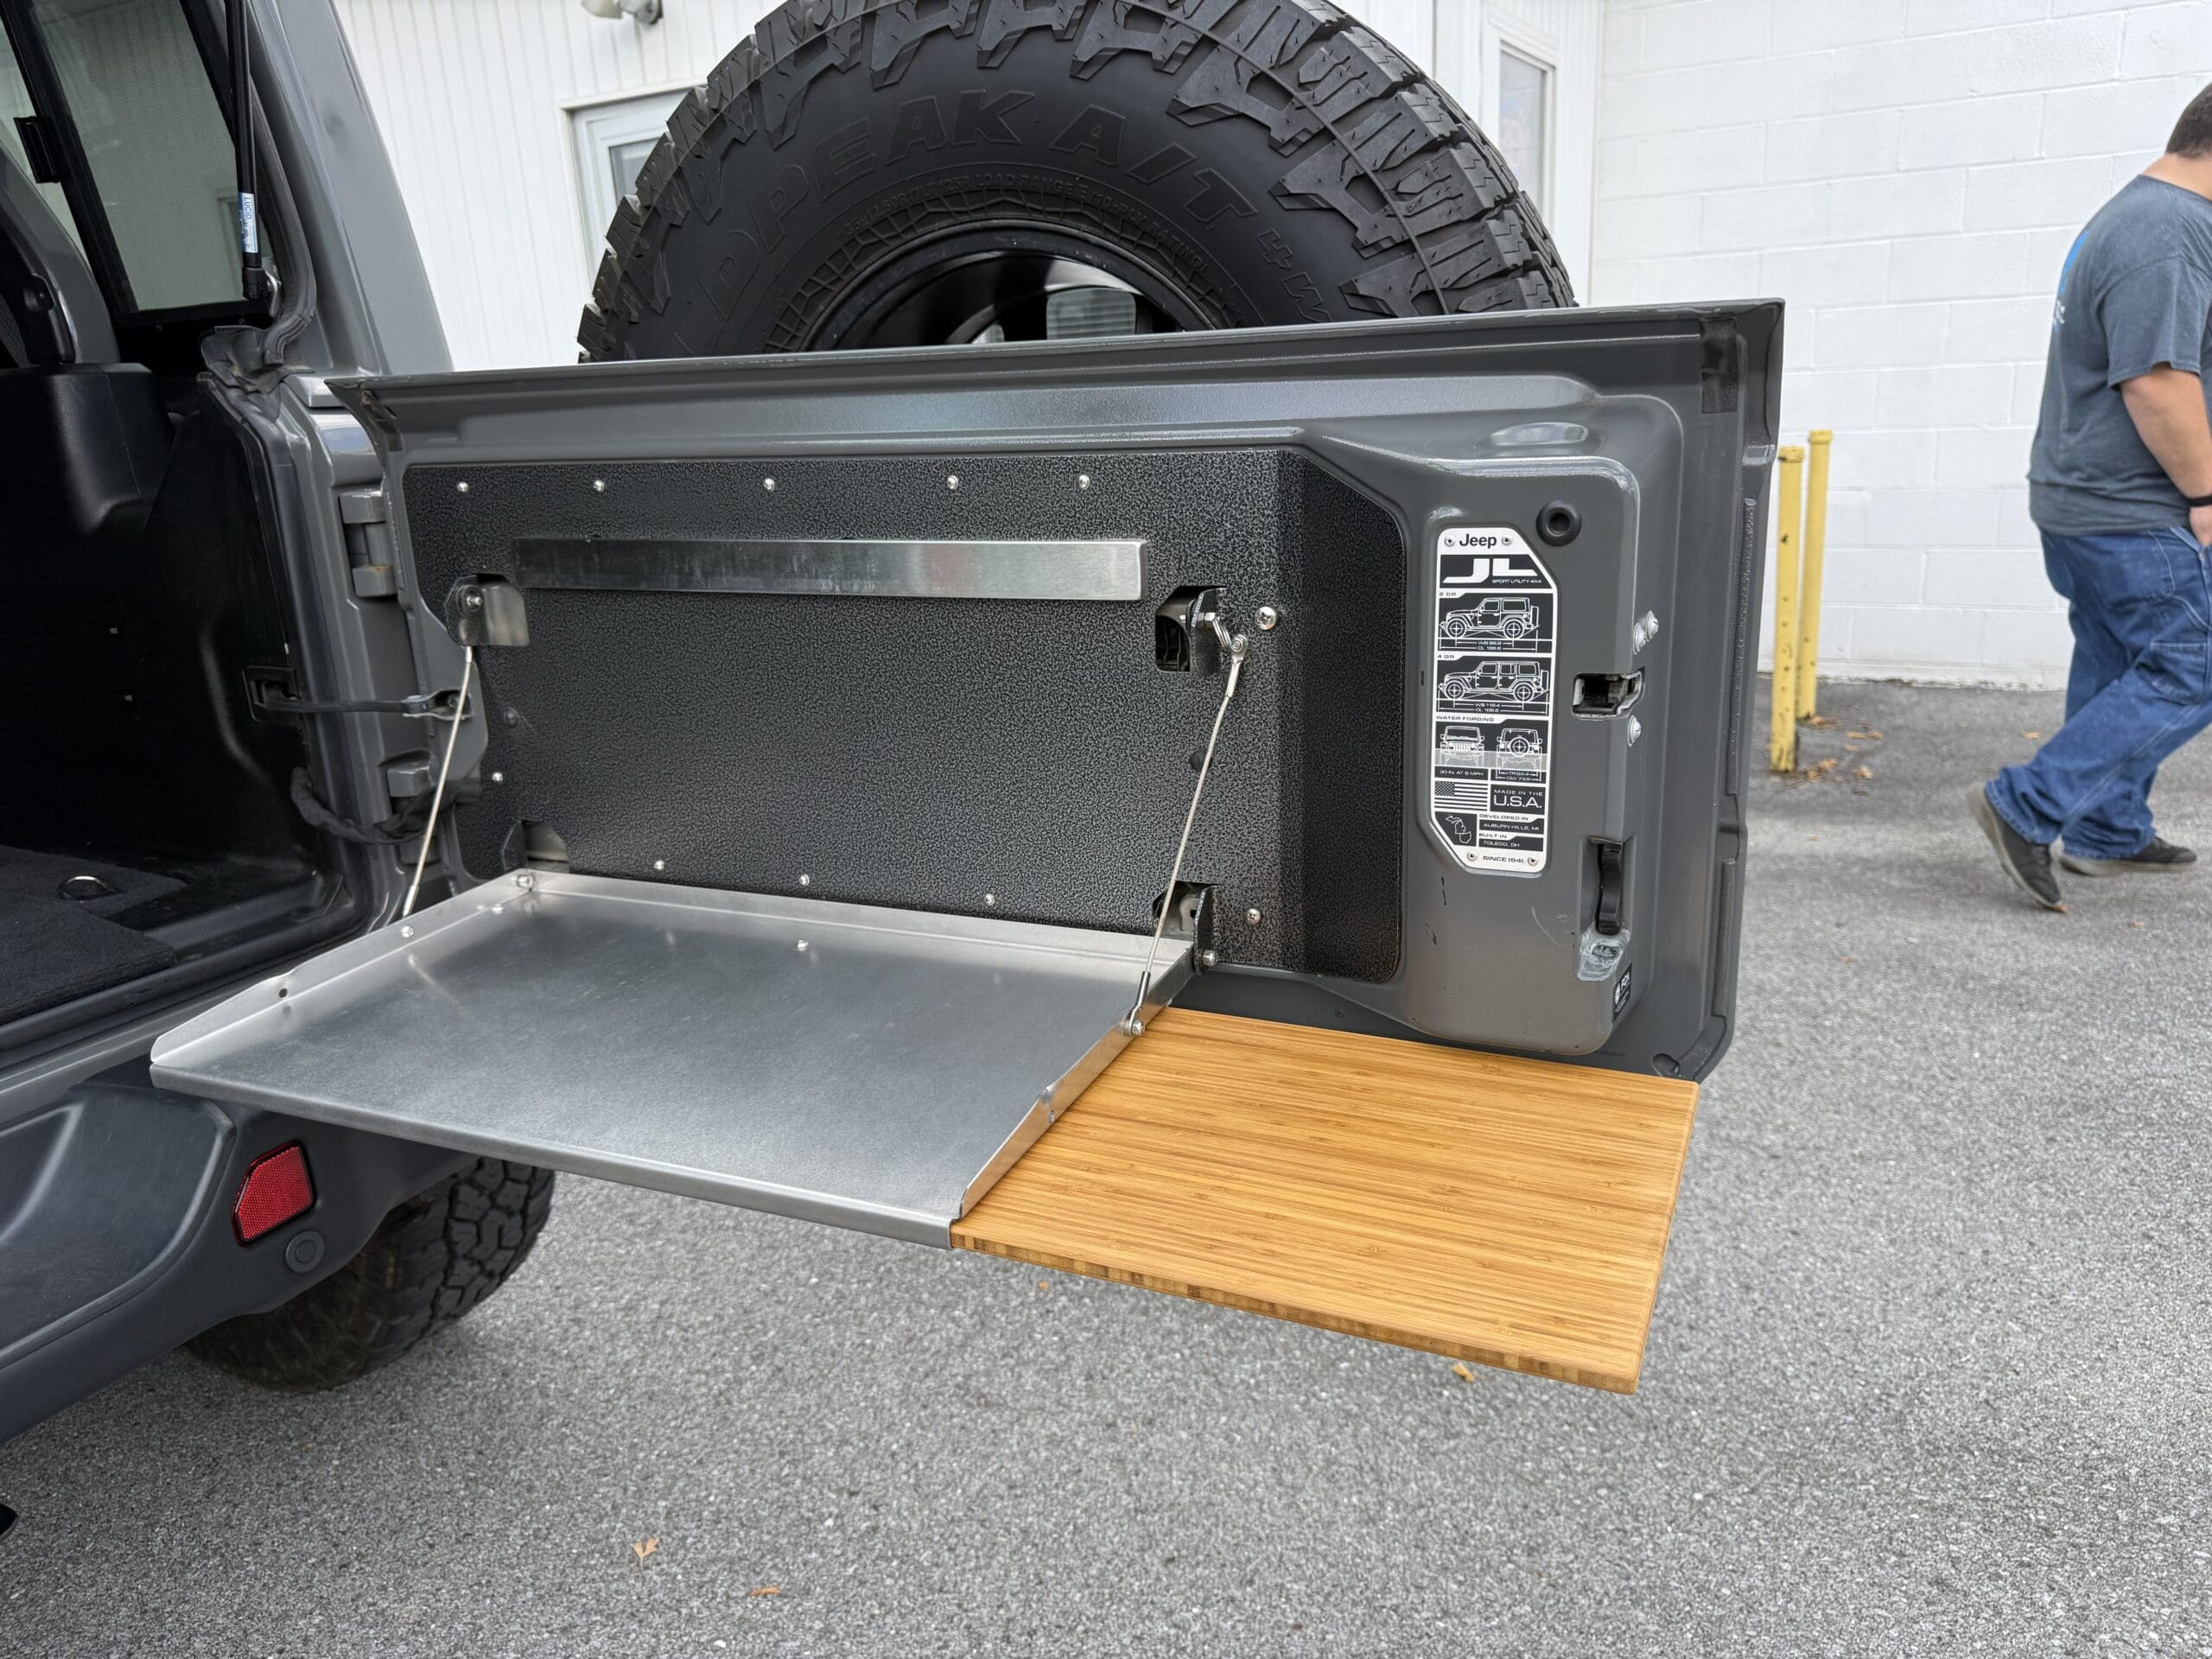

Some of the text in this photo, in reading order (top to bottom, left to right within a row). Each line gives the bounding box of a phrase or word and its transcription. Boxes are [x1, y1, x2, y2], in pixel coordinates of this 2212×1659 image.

[244, 196, 252, 220] LUCID
[1459, 533, 1497, 549] Jeep
[1442, 558, 1538, 583] JL
[1493, 794, 1542, 809] U.S.A.
